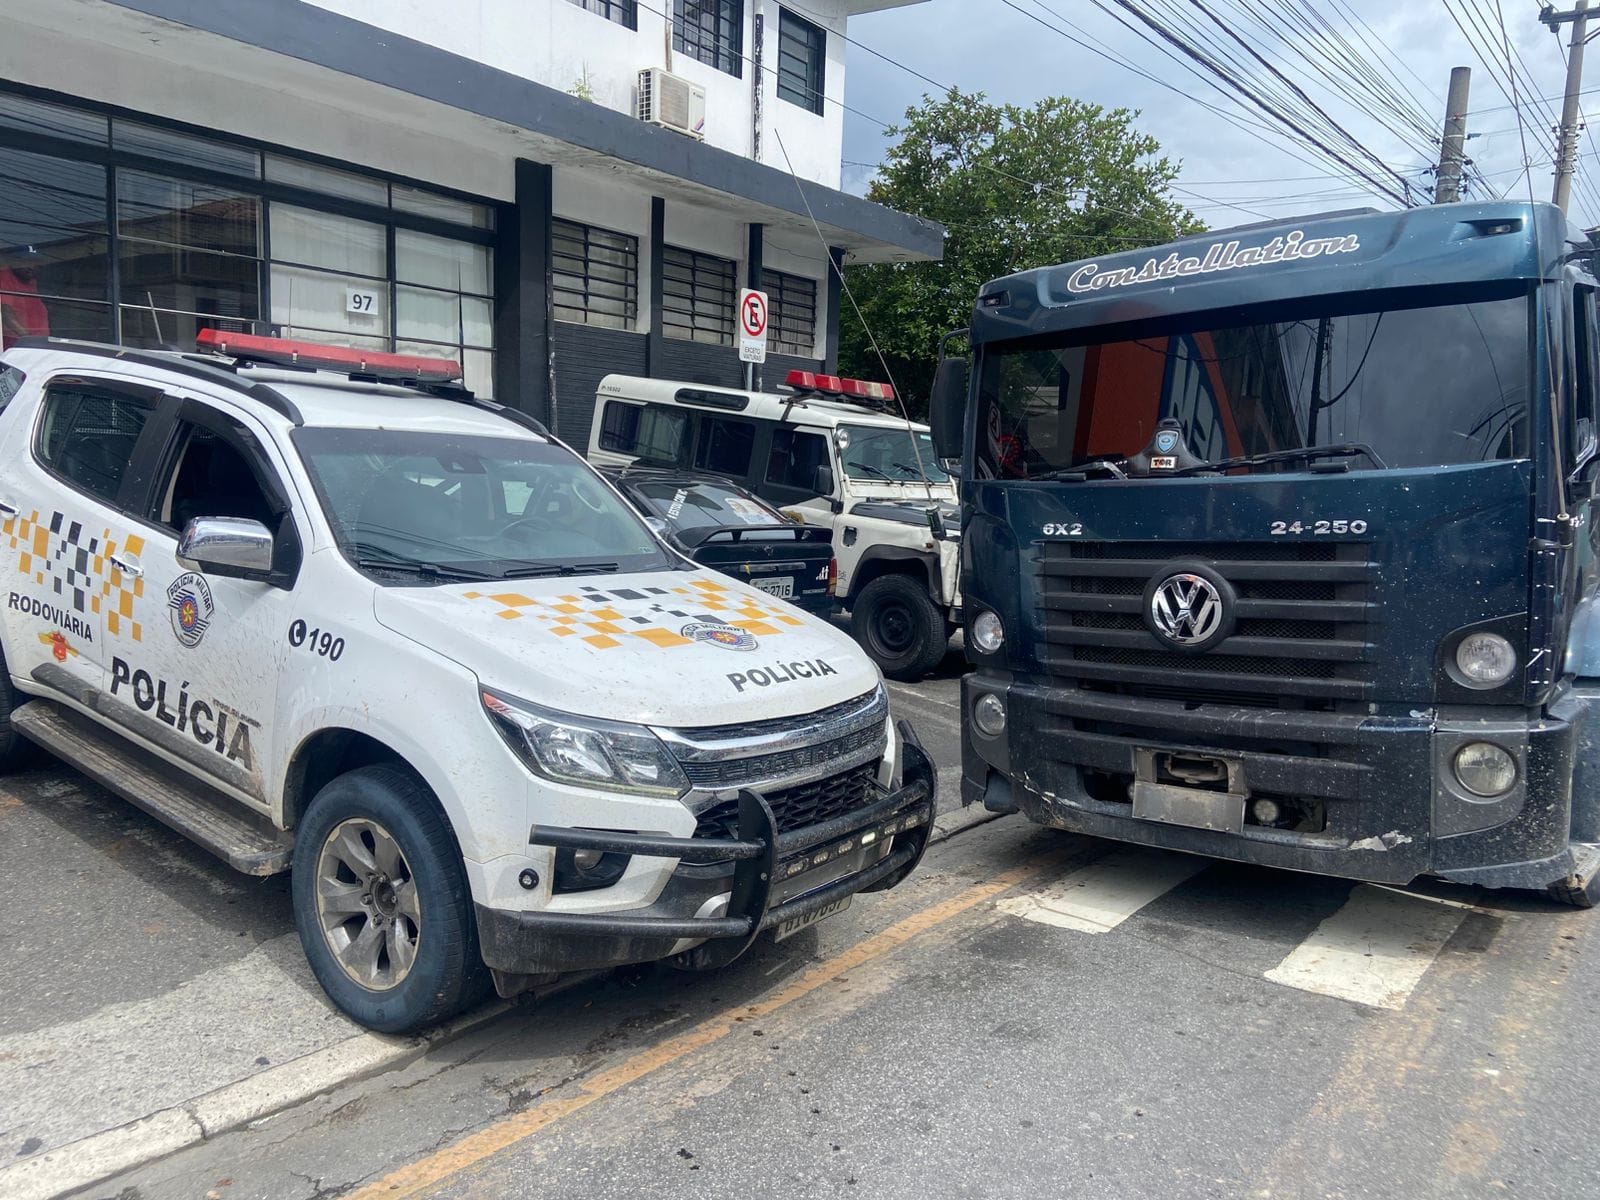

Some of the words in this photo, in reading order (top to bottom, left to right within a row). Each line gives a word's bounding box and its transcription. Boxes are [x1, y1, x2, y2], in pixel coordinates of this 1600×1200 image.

[1067, 231, 1360, 292] Constellation
[352, 294, 372, 310] 97
[1043, 523, 1083, 536] 6X2
[1270, 520, 1368, 535] 24-250
[8, 592, 93, 643] RODOVIÁRIA
[309, 628, 345, 662] 190
[726, 659, 838, 693] POLÍCIA
[110, 656, 252, 772] POLÍCIA
